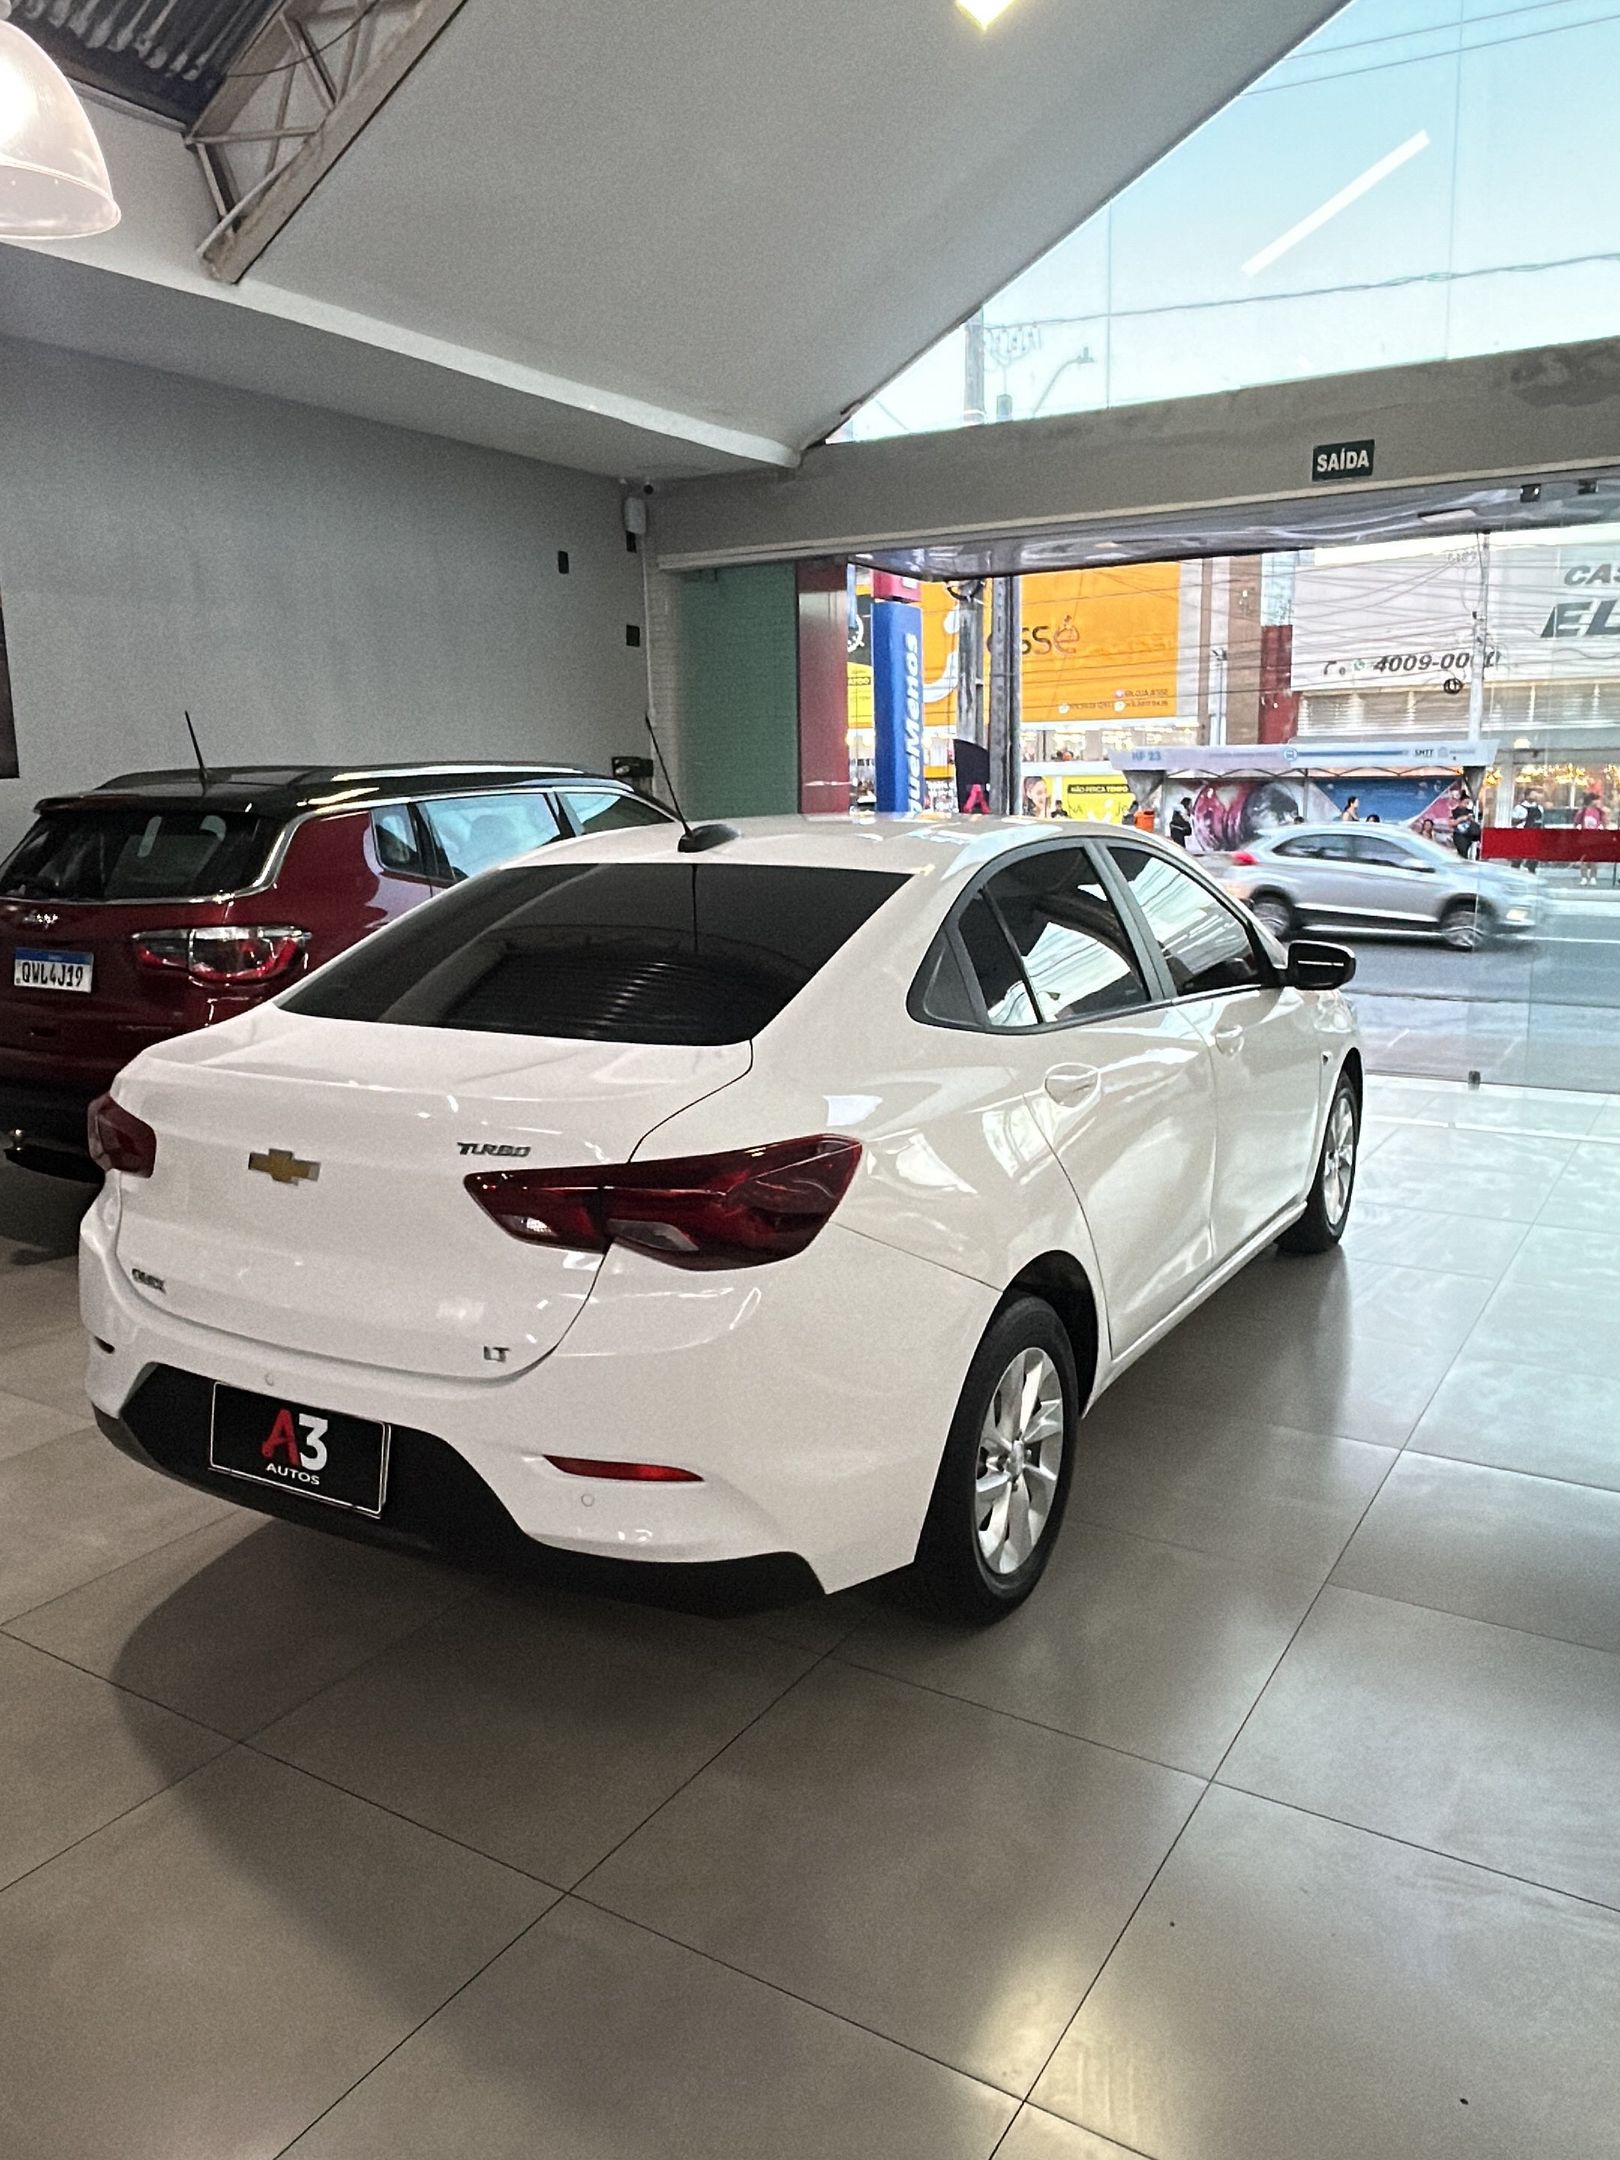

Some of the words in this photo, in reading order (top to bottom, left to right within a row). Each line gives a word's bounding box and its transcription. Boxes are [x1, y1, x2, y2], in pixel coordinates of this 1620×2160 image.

[1317, 447, 1370, 472] SAÍDA
[1564, 563, 1620, 586] CA
[457, 1142, 531, 1158] TURBO
[483, 1345, 511, 1363] LT
[262, 1408, 328, 1471] A3
[266, 1463, 320, 1486] AUTOS
